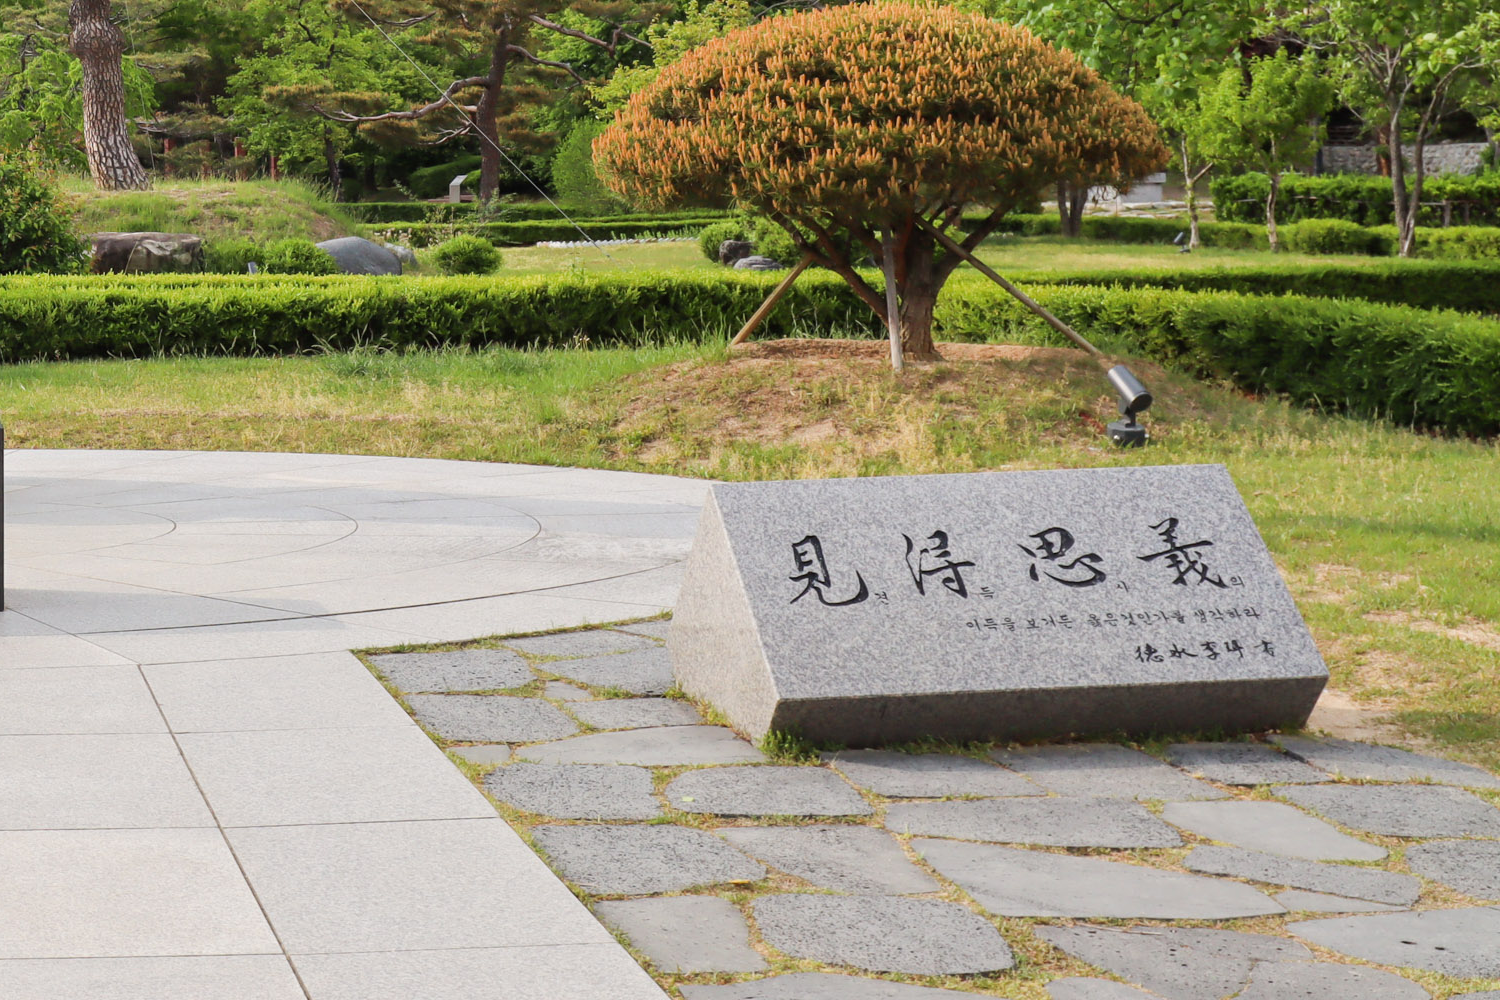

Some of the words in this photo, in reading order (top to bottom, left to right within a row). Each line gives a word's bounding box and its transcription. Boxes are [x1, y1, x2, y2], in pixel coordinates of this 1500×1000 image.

[980, 586, 995, 599] 득
[1117, 581, 1129, 593] 사
[1230, 575, 1246, 588] 의
[966, 617, 1015, 632] 이득을
[1027, 614, 1072, 629] 보거든
[1194, 607, 1261, 623] 생각하라
